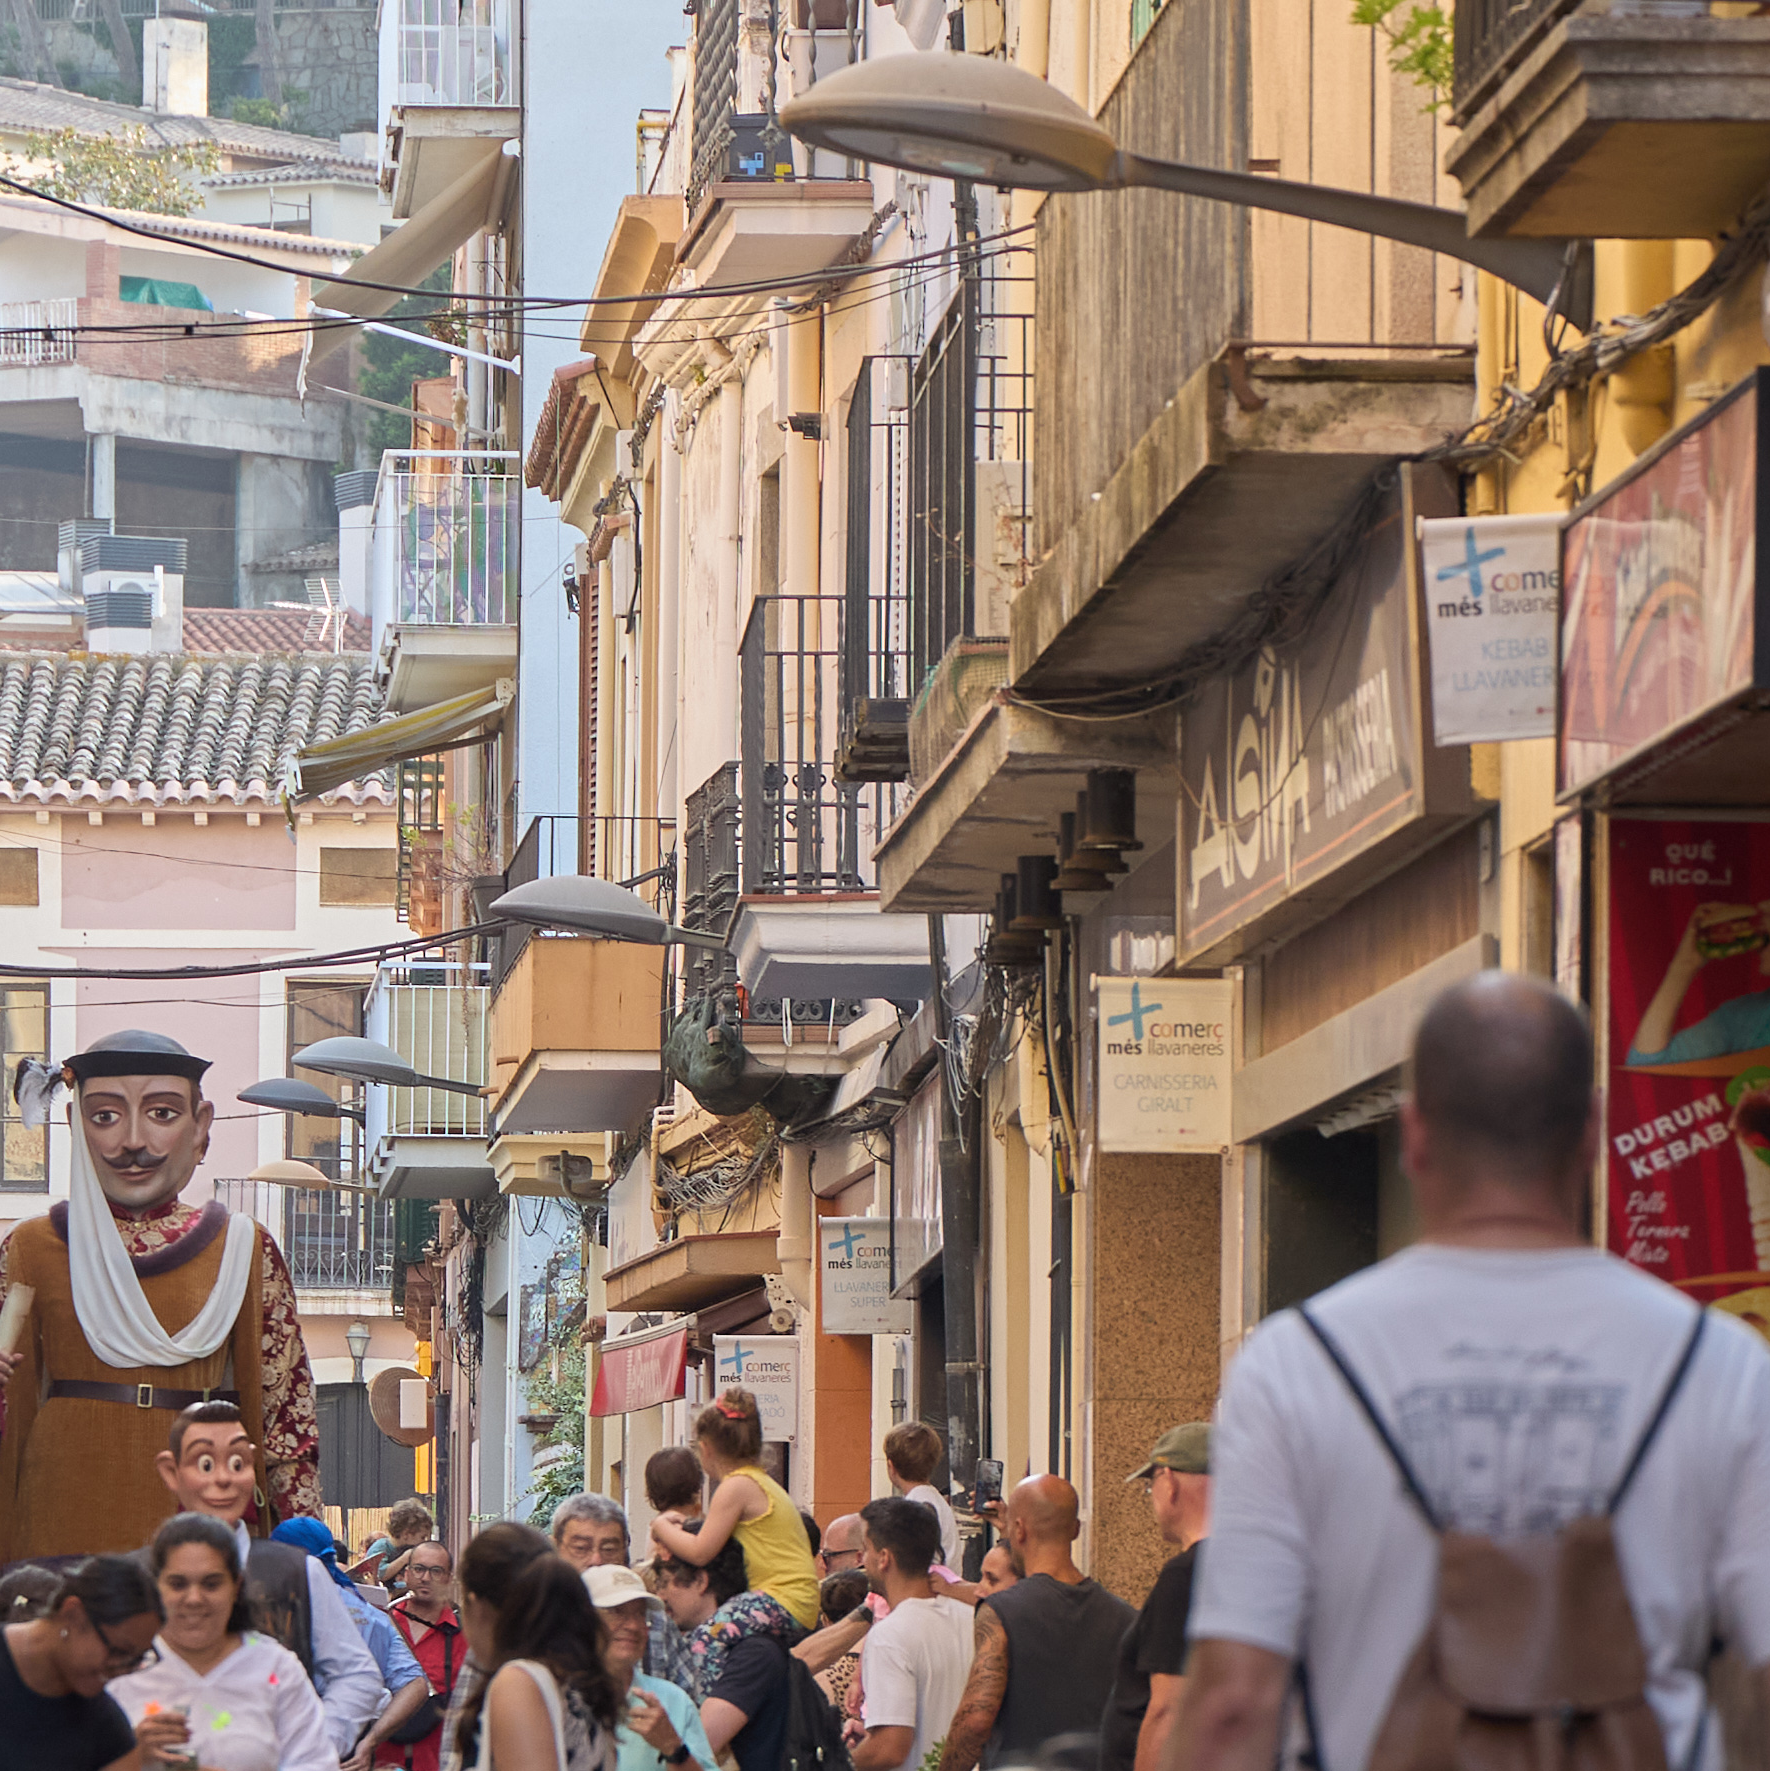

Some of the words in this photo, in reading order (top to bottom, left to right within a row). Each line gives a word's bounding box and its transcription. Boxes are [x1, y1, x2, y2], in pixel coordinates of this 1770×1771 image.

[1490, 570, 1560, 593] come
[1437, 596, 1483, 618] més
[1489, 594, 1560, 615] llavane
[1481, 638, 1548, 660] KEBAB
[1150, 1023, 1224, 1042] comerç
[1107, 1038, 1142, 1055] més
[1148, 1039, 1224, 1055] llavaneres
[1114, 1074, 1217, 1090] CARNISSERIA
[1138, 1096, 1193, 1112] GIRALT
[1614, 1093, 1723, 1156] DURUM
[1630, 1122, 1729, 1180] KEBAB
[829, 1258, 852, 1269] més
[851, 1296, 886, 1307] SUPER
[746, 1362, 791, 1374] comerç
[720, 1372, 742, 1383] més
[745, 1372, 792, 1383] llavaneres
